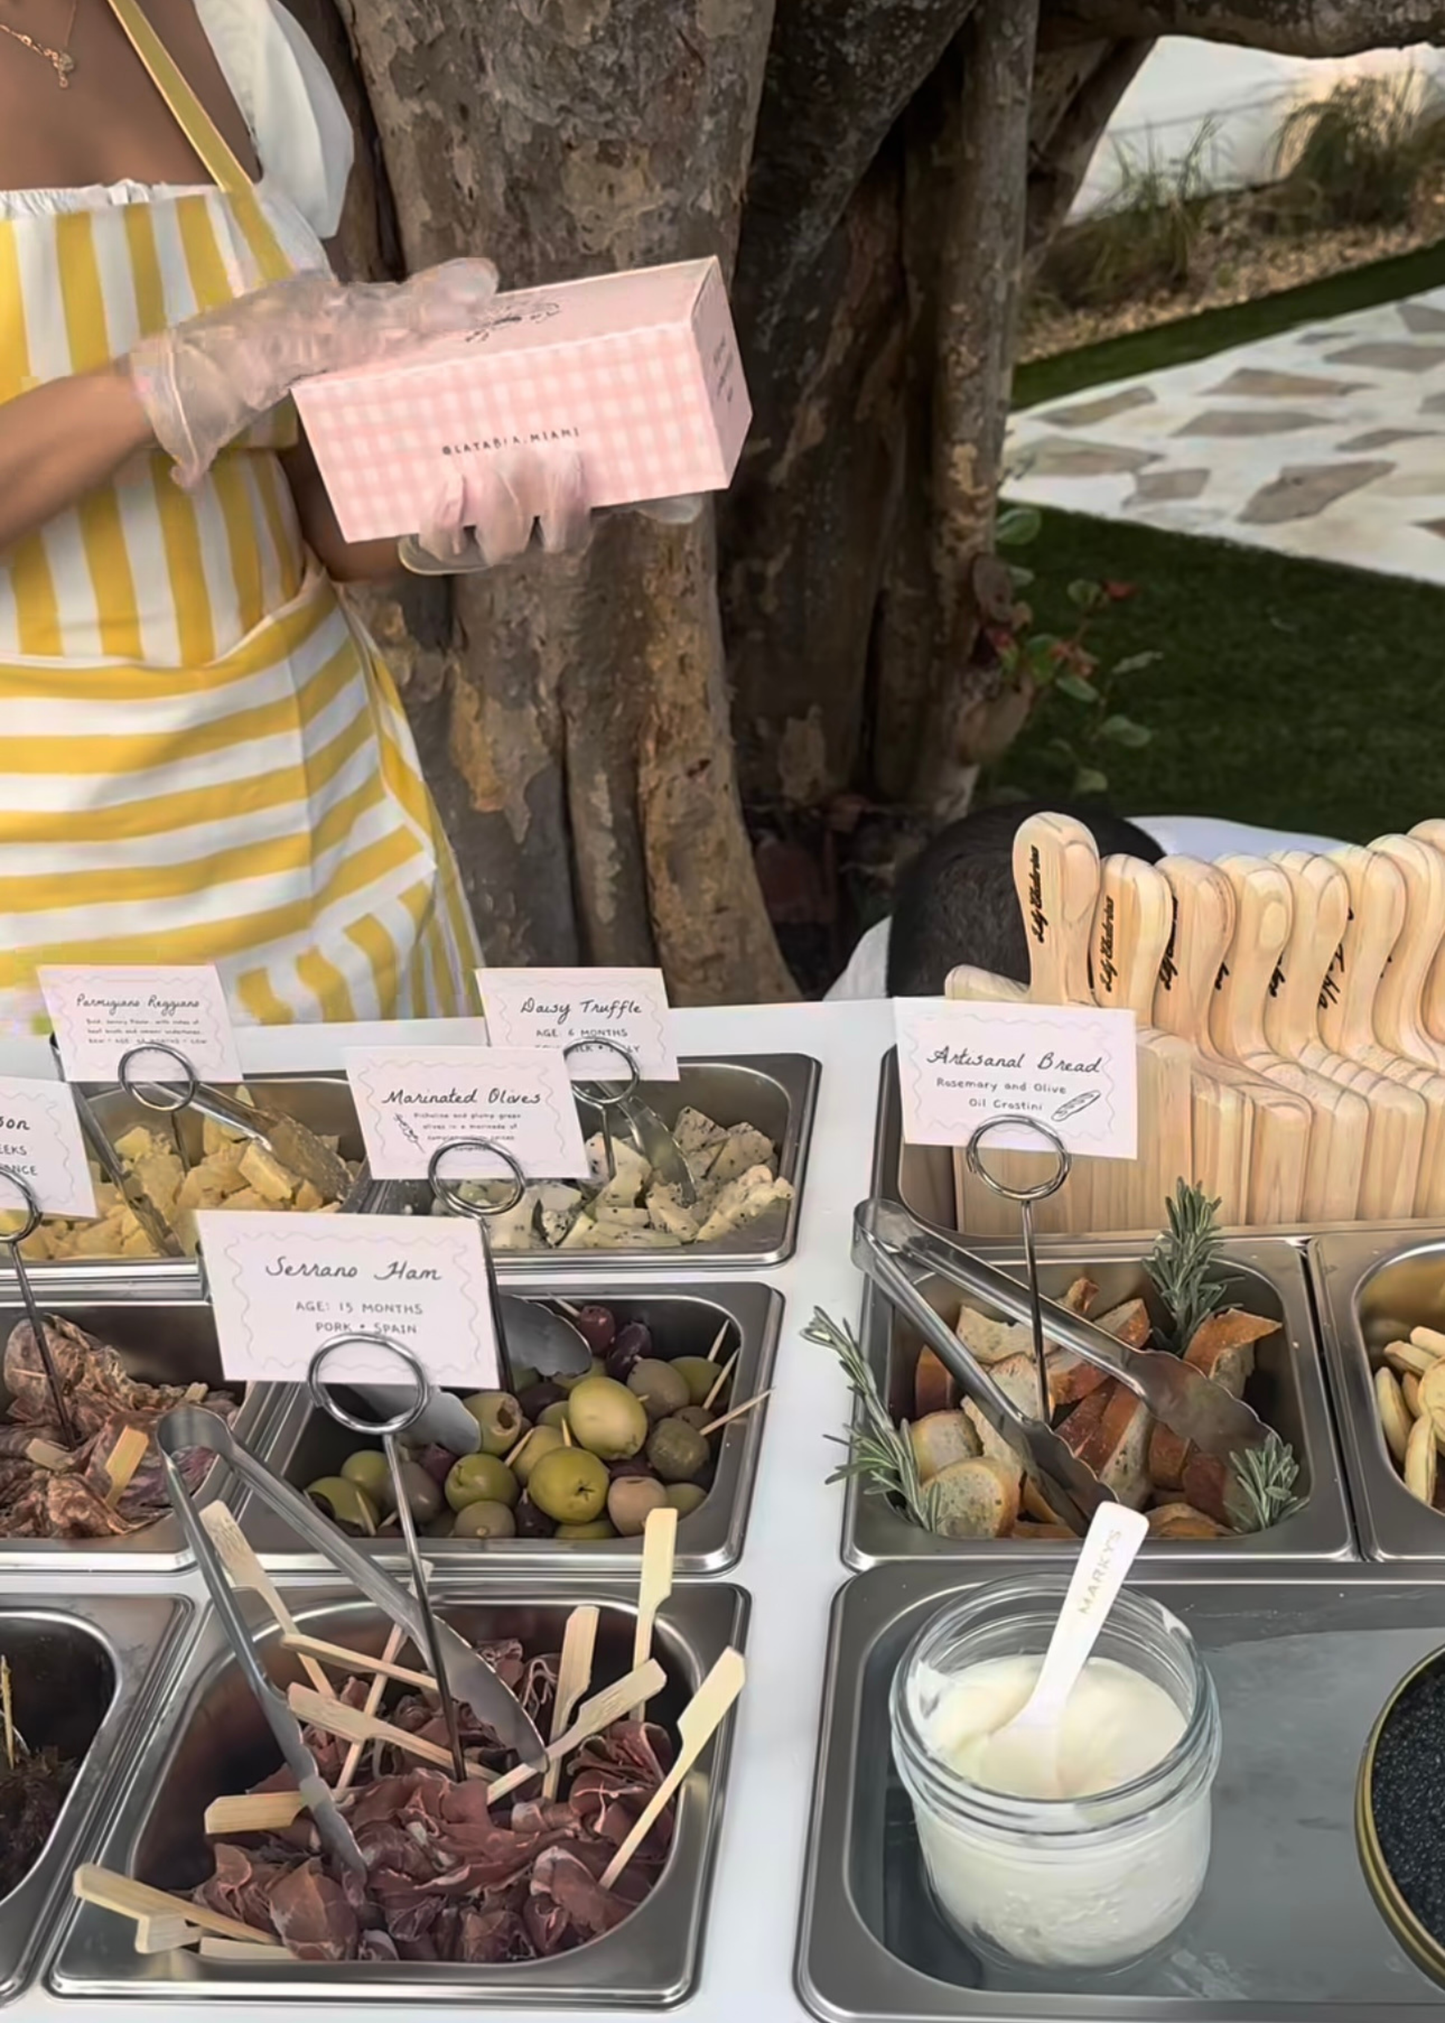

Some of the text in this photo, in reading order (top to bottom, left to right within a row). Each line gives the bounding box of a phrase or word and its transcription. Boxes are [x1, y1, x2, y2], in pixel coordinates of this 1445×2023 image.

[76, 993, 200, 1017] Parmigiano Reggiano
[520, 997, 642, 1025] Daisy Truffle
[568, 1028, 575, 1037] 6
[580, 1029, 629, 1038] MONTHS
[926, 1045, 1102, 1073] Artisanal Bread
[936, 1077, 1067, 1094] Rosemary and Olive
[382, 1087, 541, 1104] Marinated Olives
[968, 1098, 1043, 1111] Oil Crostini
[265, 1256, 442, 1281] Serrano Ham
[295, 1300, 424, 1315] AGE: 15 MONTHS
[315, 1322, 418, 1335] PORK SPAIN
